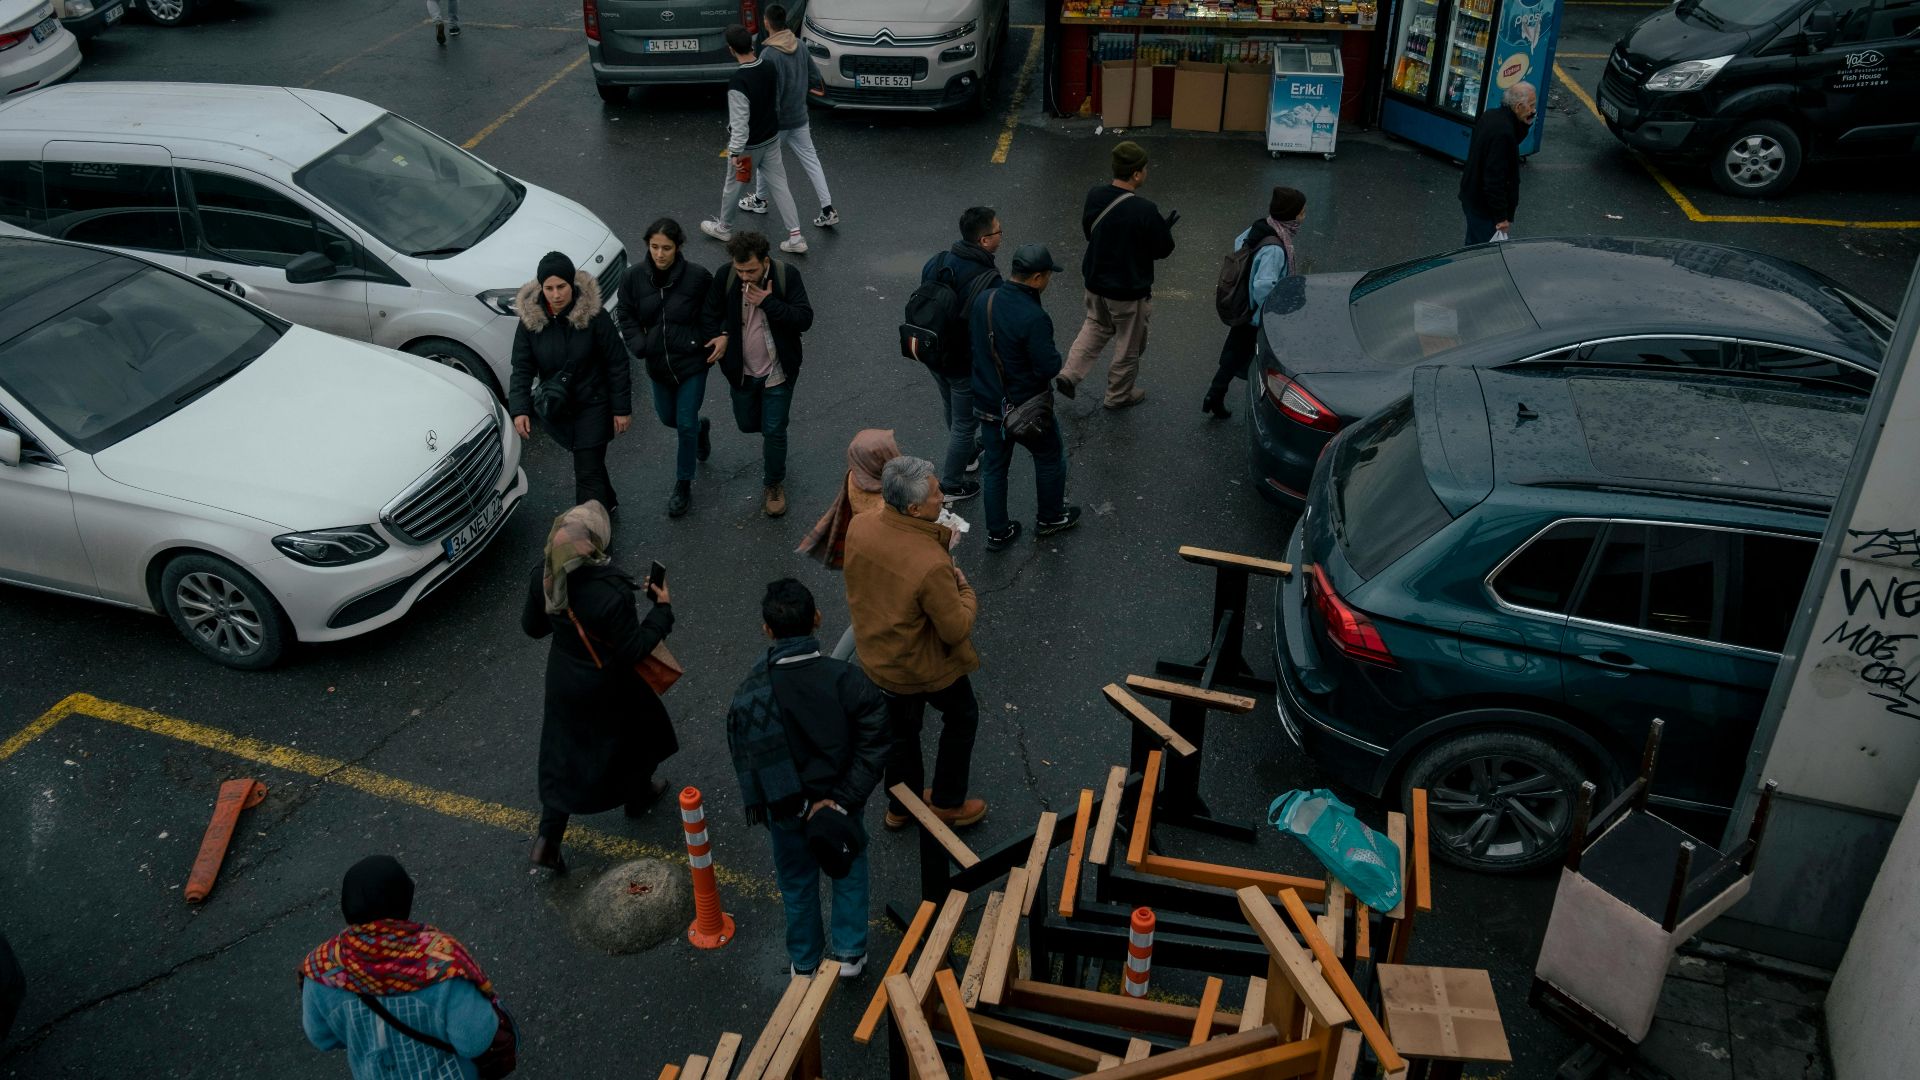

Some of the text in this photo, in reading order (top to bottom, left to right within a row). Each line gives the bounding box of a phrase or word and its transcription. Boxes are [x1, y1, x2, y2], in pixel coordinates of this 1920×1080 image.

[650, 40, 697, 50] 34 FEJ 423
[860, 76, 909, 86] 34 CFE 523
[1291, 82, 1323, 95] Erikli
[453, 531, 467, 551] 34
[469, 509, 489, 538] NEV
